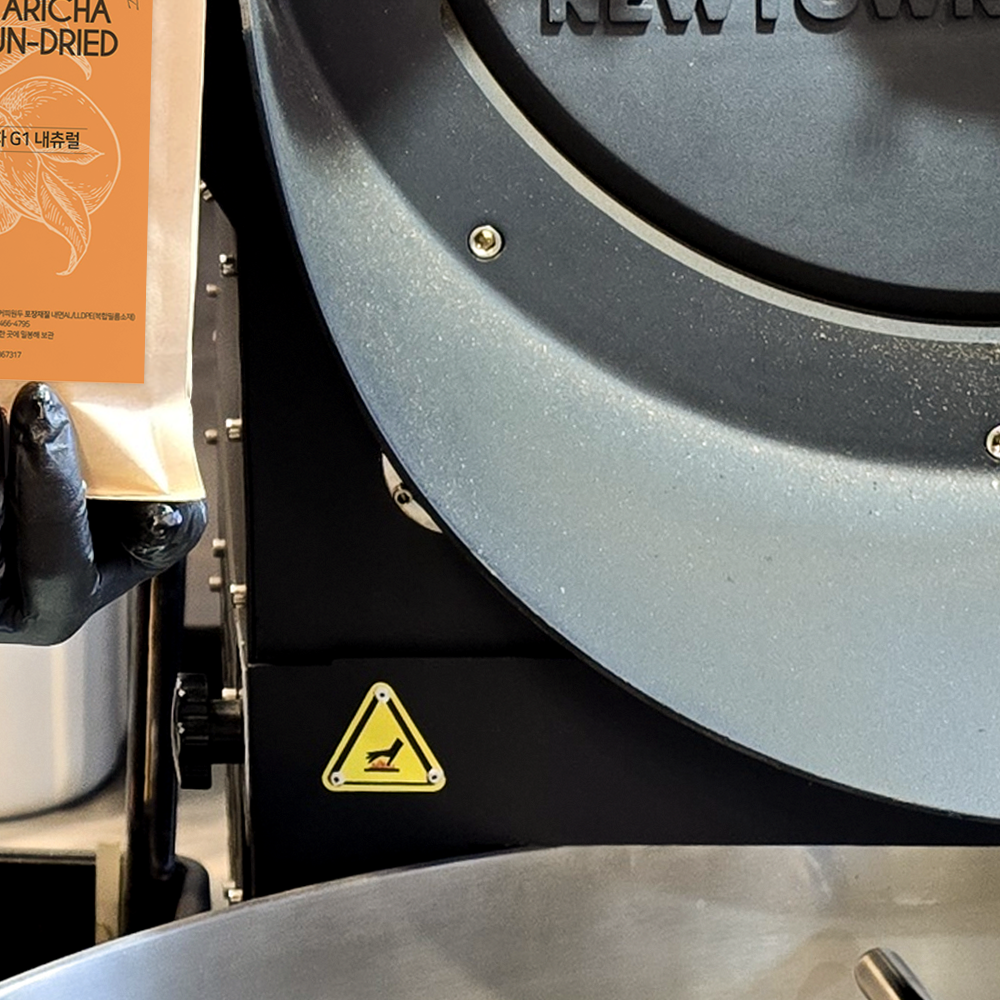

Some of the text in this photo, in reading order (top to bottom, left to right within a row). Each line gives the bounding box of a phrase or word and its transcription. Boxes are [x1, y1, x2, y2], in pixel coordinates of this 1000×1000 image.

[10, 131, 30, 147] G1
[34, 131, 81, 149] 내츄럴
[41, 331, 54, 340] 보관
